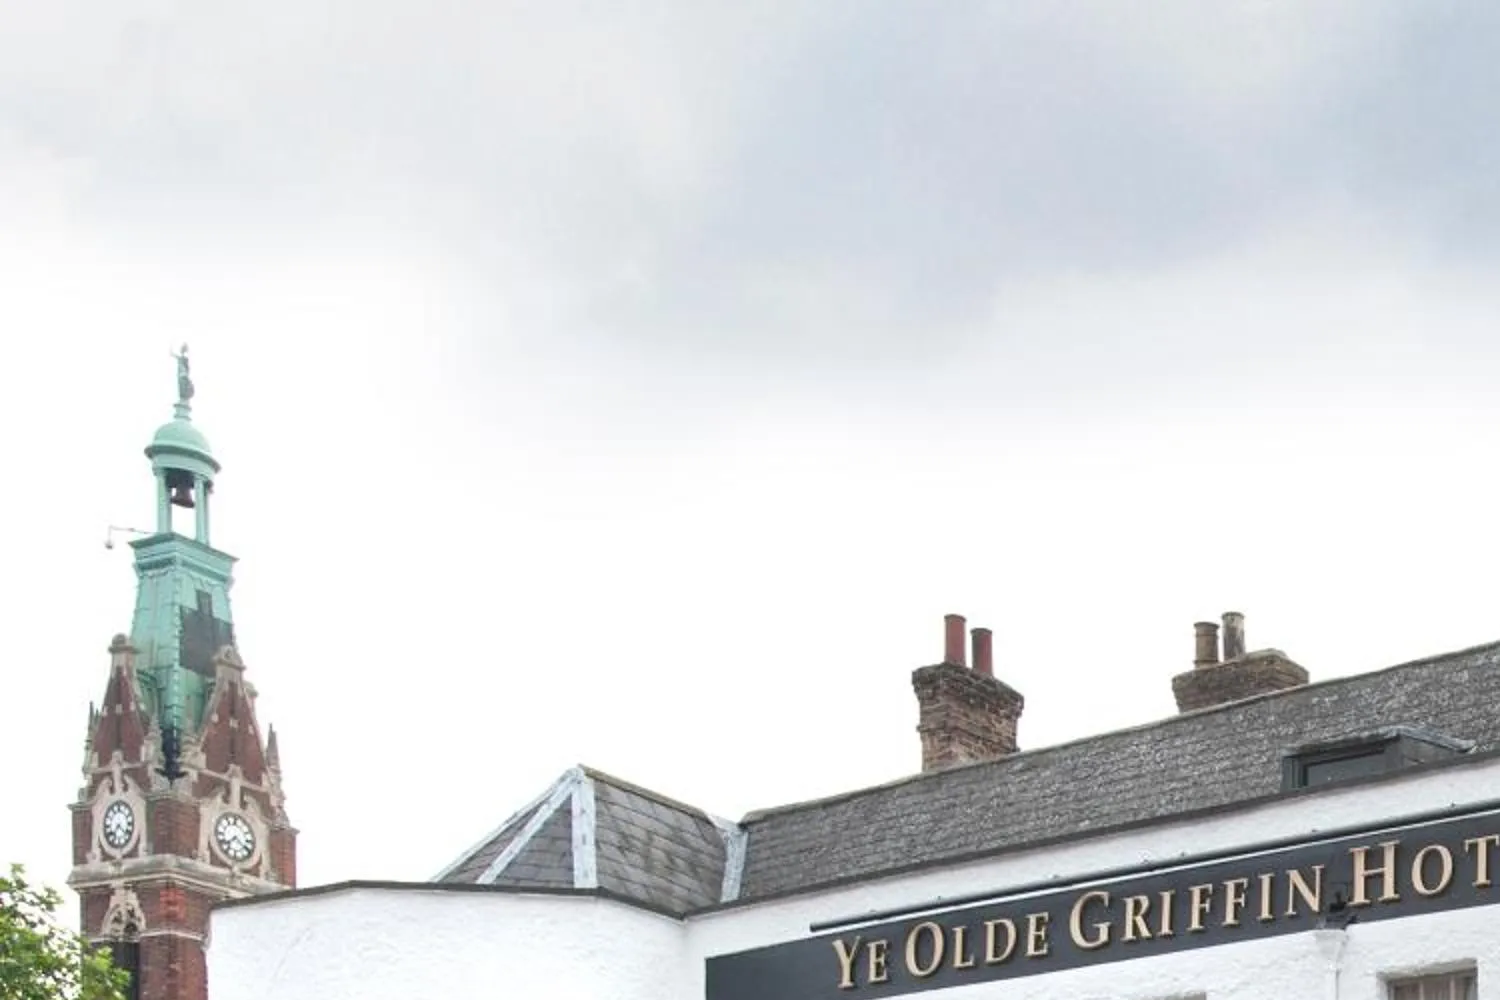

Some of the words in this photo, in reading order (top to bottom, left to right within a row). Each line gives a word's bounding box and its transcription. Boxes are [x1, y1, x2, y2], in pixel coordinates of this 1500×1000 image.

[832, 935, 889, 990] YE
[904, 911, 1051, 978] OLDE
[1069, 864, 1325, 950] GRIFFIN
